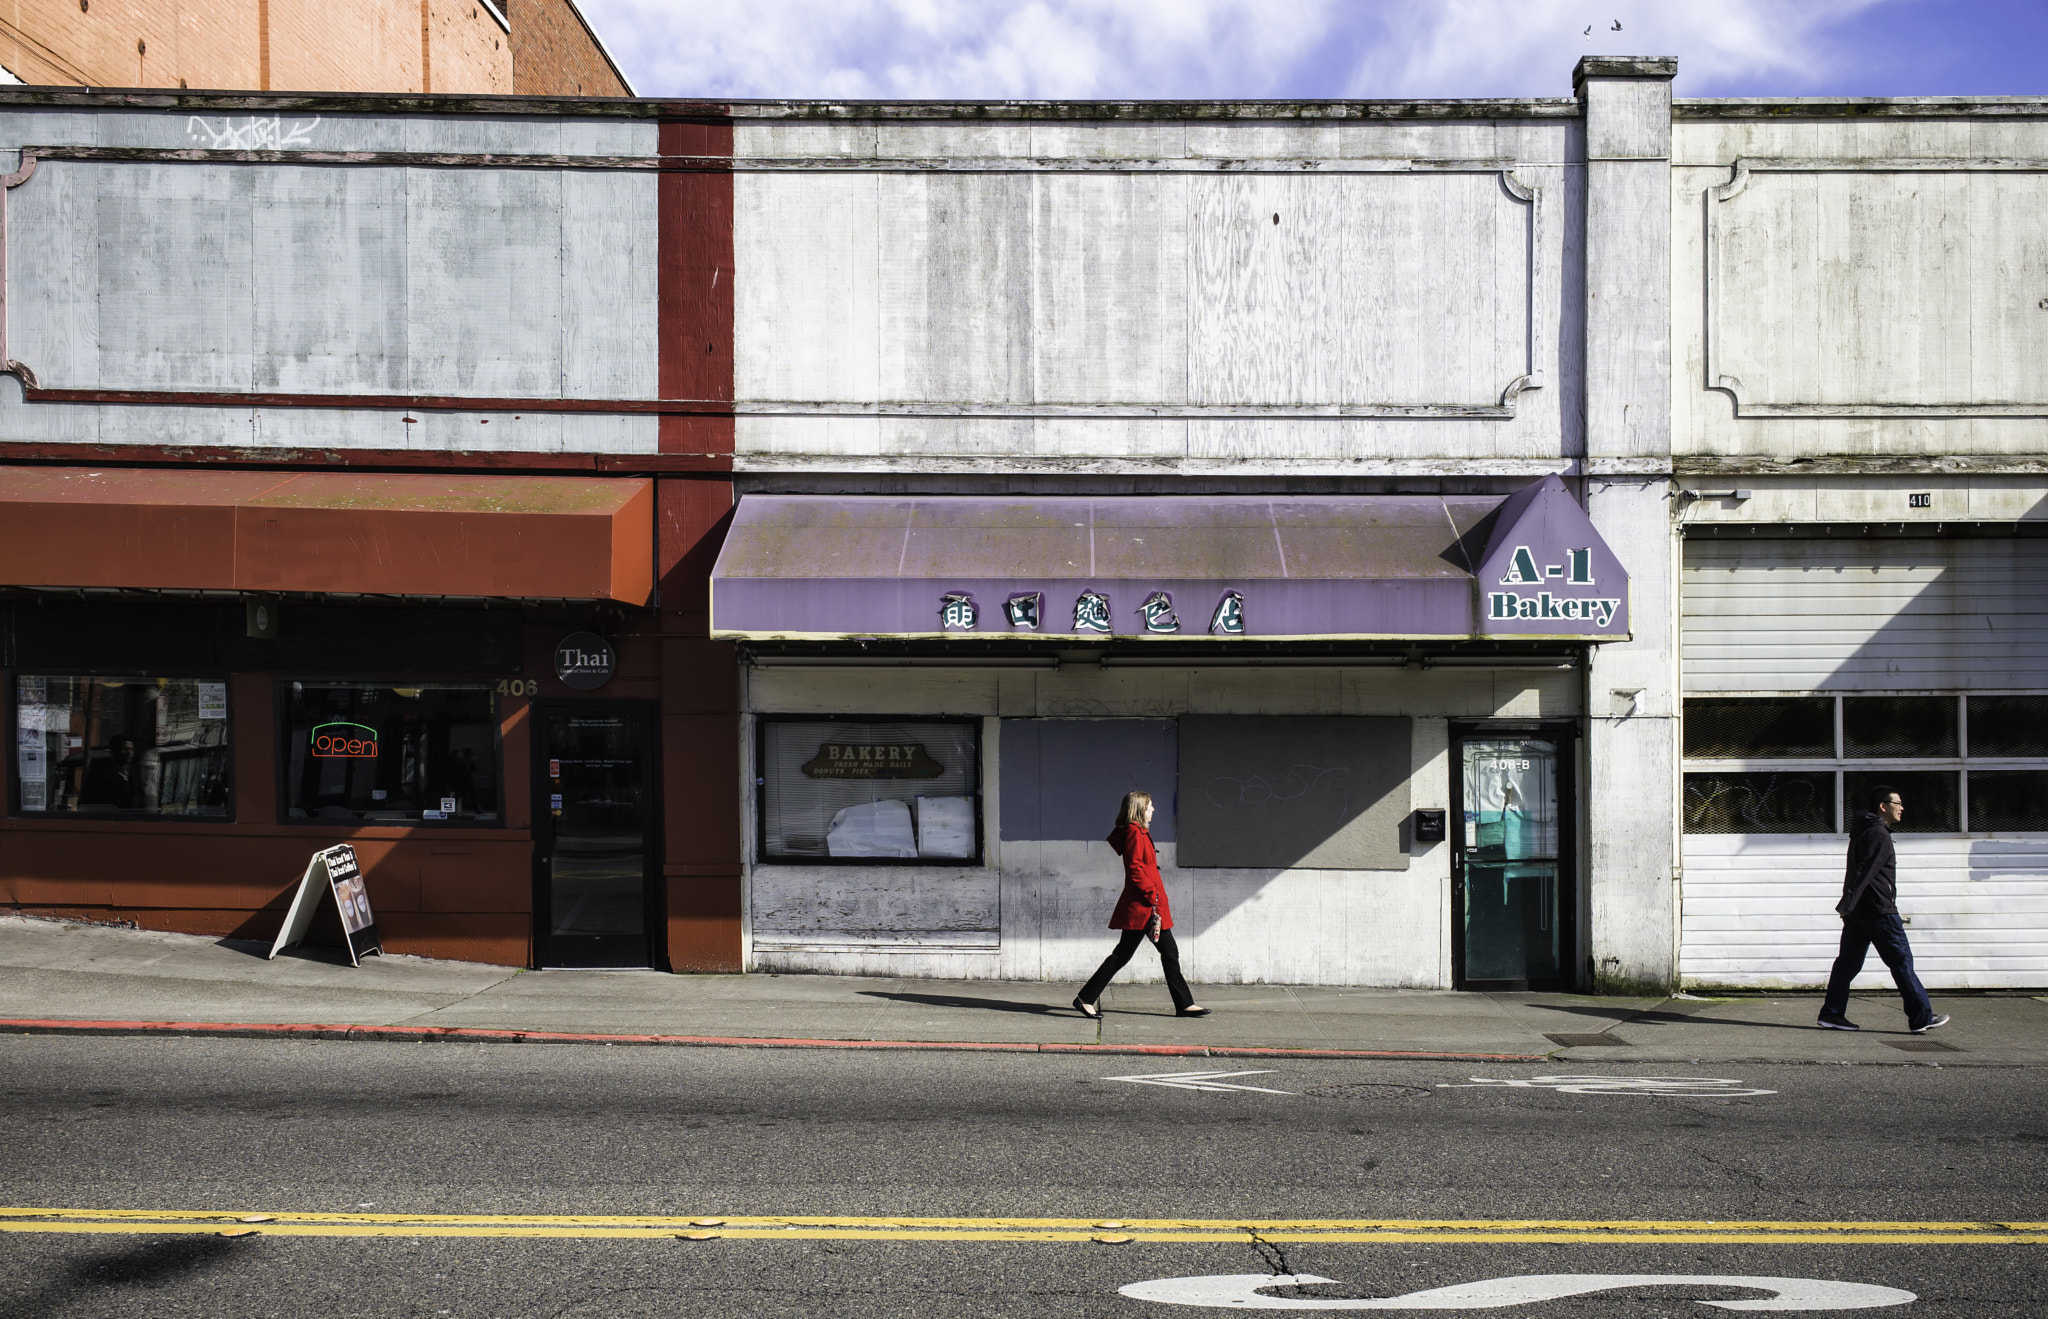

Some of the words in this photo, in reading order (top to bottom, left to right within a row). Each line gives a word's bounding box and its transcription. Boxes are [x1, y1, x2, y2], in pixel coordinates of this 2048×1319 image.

[1910, 494, 1930, 506] 410
[1499, 545, 1595, 585] A-1
[1488, 591, 1621, 628] Bakery
[560, 648, 609, 667] Thai
[497, 679, 538, 697] 406
[316, 735, 375, 756] open
[828, 746, 916, 760] BAKERY
[1490, 759, 1530, 770] 408-B
